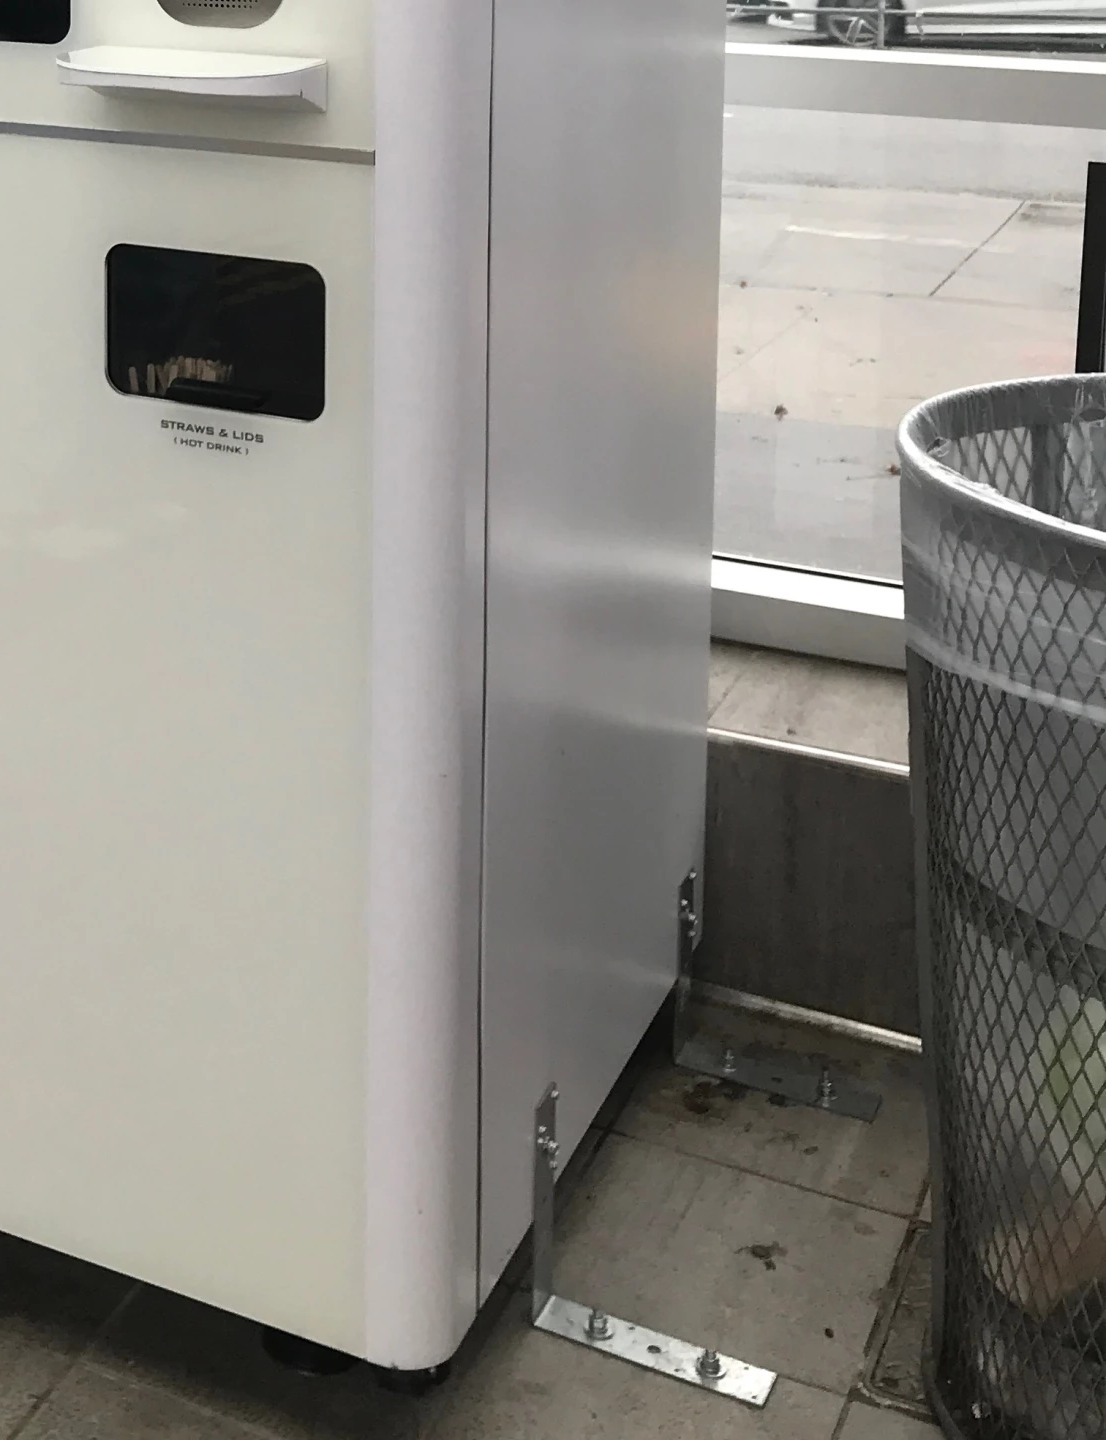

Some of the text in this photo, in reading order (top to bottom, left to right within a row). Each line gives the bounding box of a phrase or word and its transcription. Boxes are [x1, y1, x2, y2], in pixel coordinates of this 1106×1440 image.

[161, 419, 264, 444] STRAWS & LIDS
[180, 438, 204, 448] HOT
[206, 442, 242, 455] DRINK
